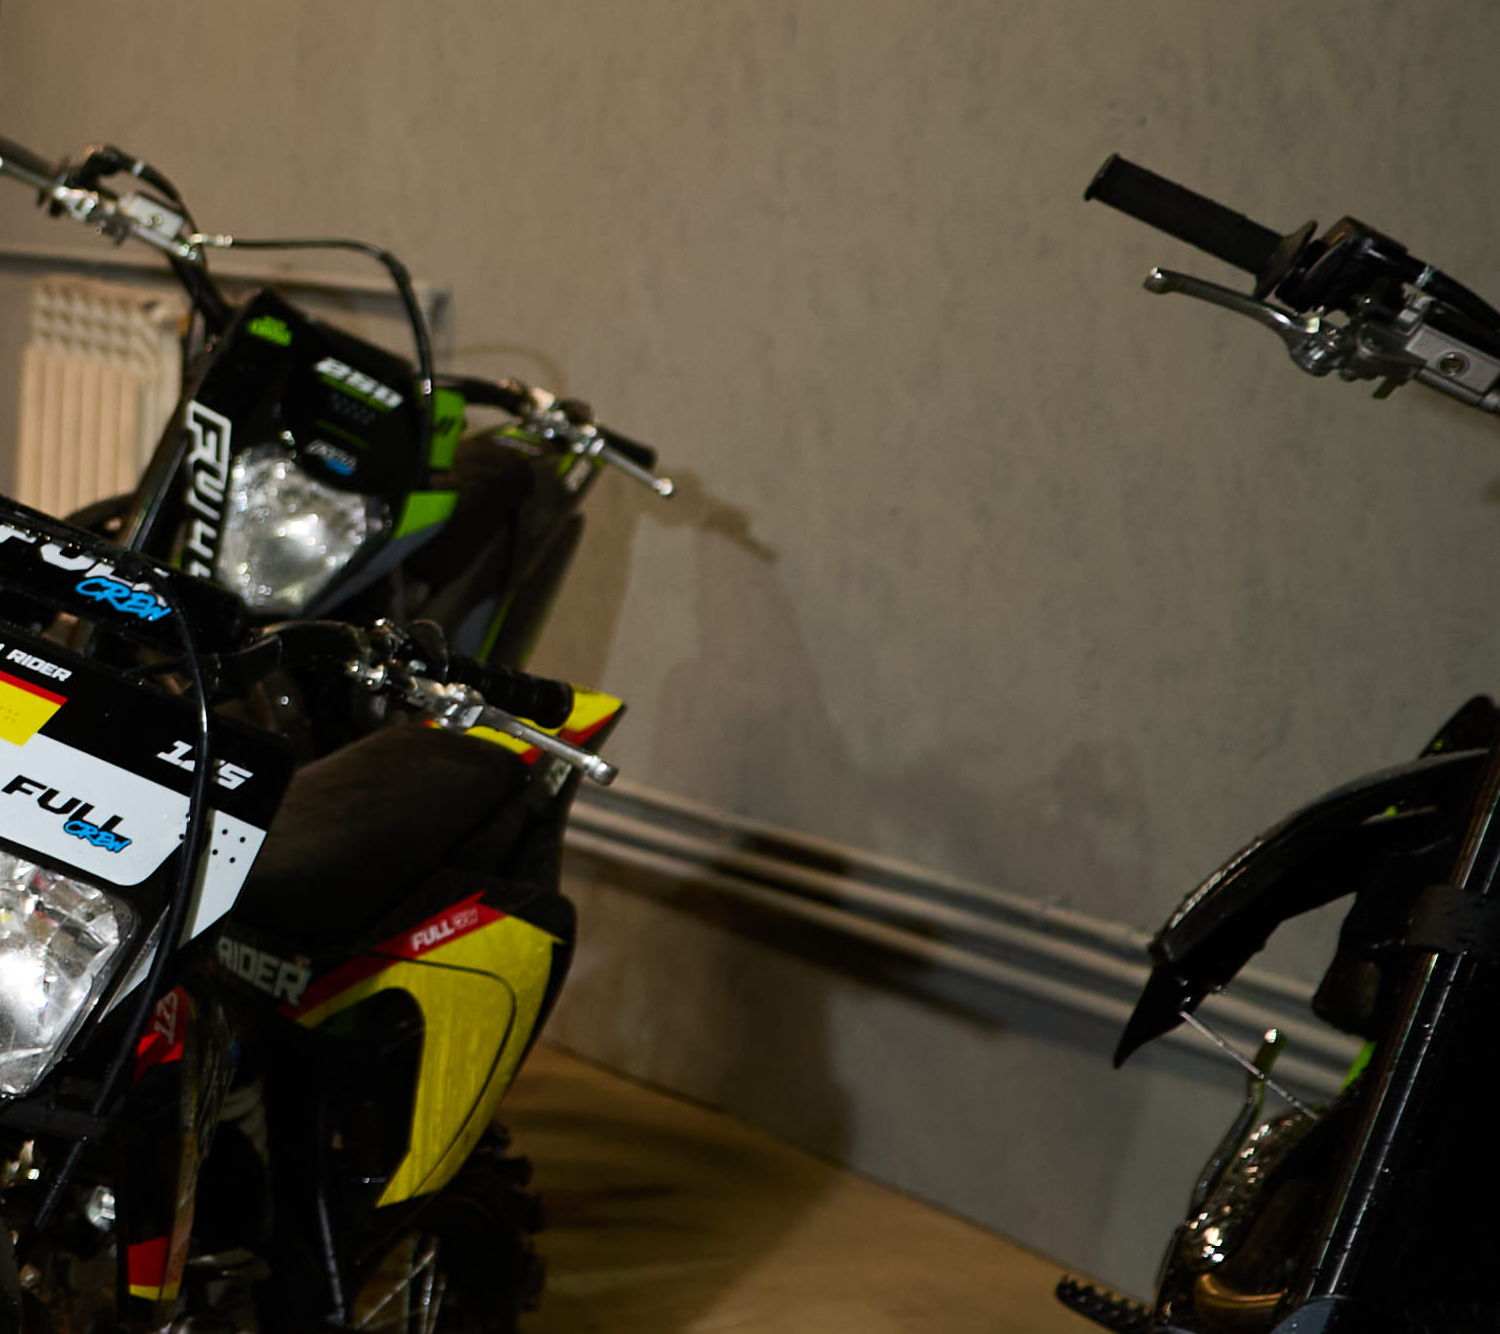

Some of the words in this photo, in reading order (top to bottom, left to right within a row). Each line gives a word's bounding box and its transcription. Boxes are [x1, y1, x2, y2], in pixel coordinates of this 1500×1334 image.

[76, 576, 172, 622] CREW
[7, 645, 73, 683] RIDER
[156, 739, 253, 792] 15
[1, 774, 126, 835] FULL
[63, 819, 132, 853] CREW
[410, 919, 455, 952] FULL
[218, 935, 313, 1008] RIDER
